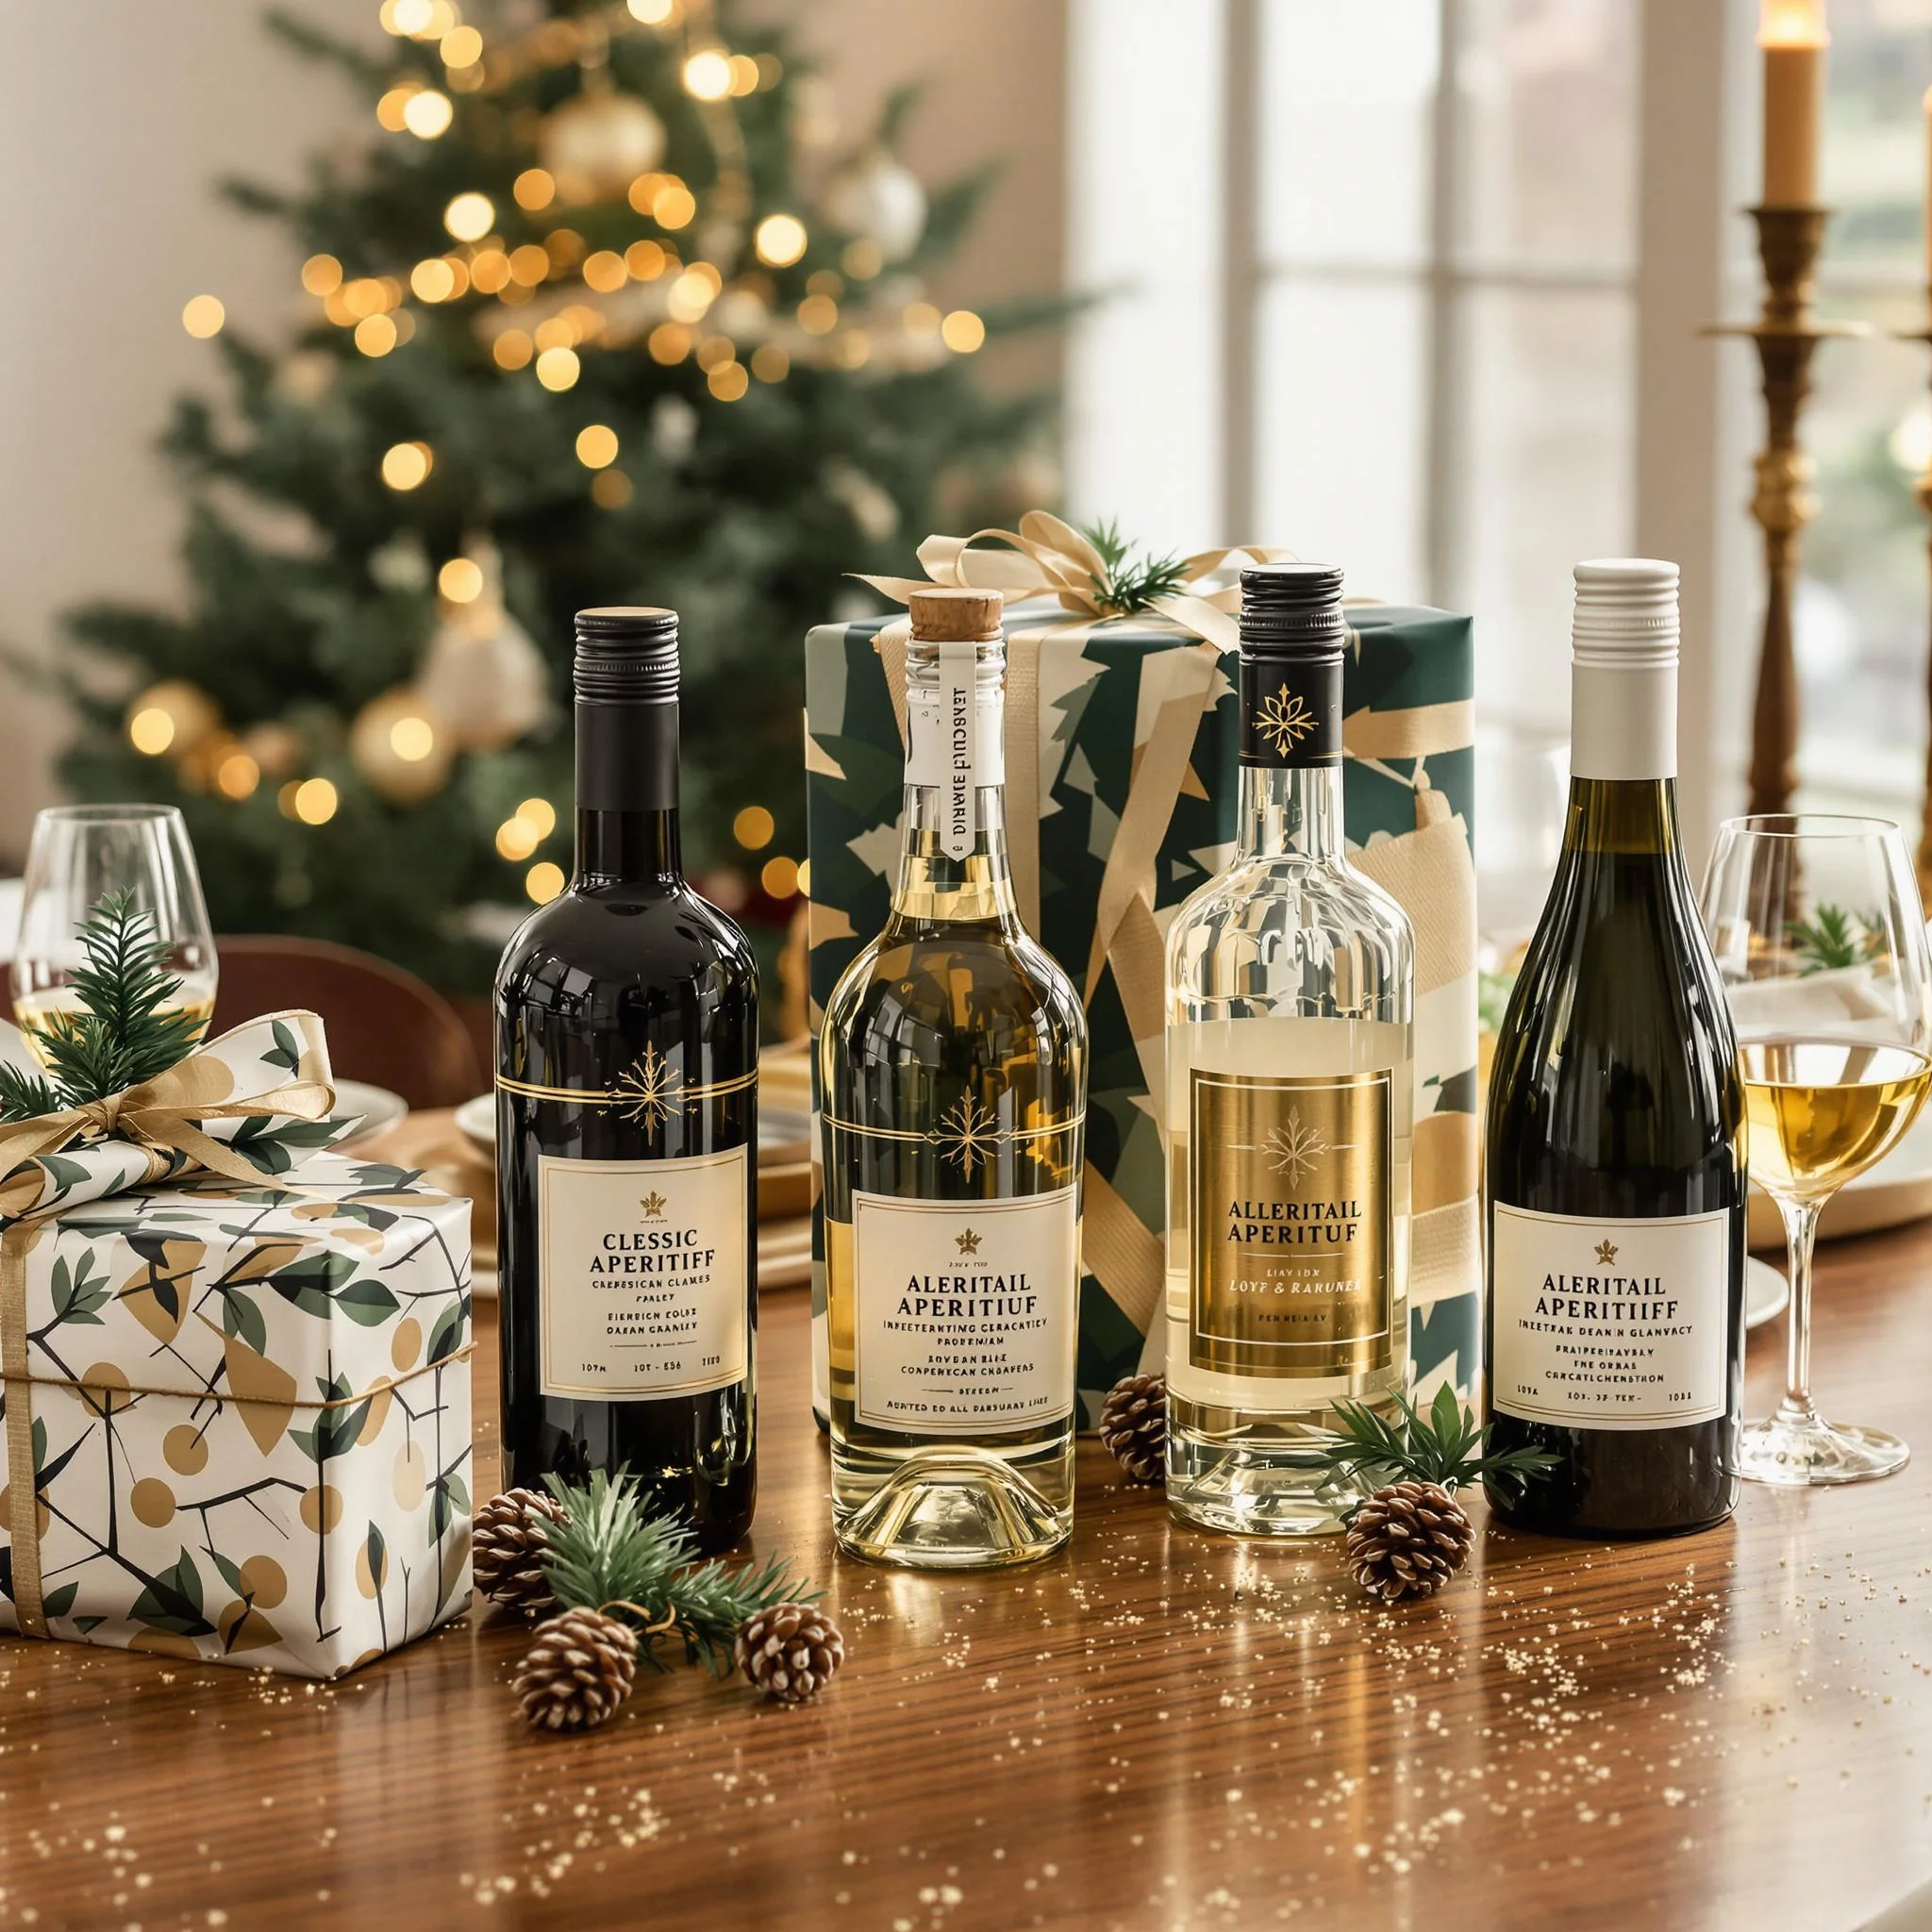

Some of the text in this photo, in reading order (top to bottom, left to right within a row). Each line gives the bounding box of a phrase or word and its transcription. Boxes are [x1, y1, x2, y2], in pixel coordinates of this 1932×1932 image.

[1228, 1200, 1362, 1221] ALLERITAIL
[603, 1229, 697, 1251] CLESSIC
[1227, 1224, 1357, 1244] APERITUF
[590, 1249, 715, 1274] APERITIFF
[907, 1274, 1031, 1293] ALERITAIL
[1274, 1282, 1285, 1294] &
[1542, 1274, 1667, 1295] ALERITAIL
[897, 1295, 1037, 1317] APERITIUF
[1535, 1296, 1678, 1320] APERITIIFF
